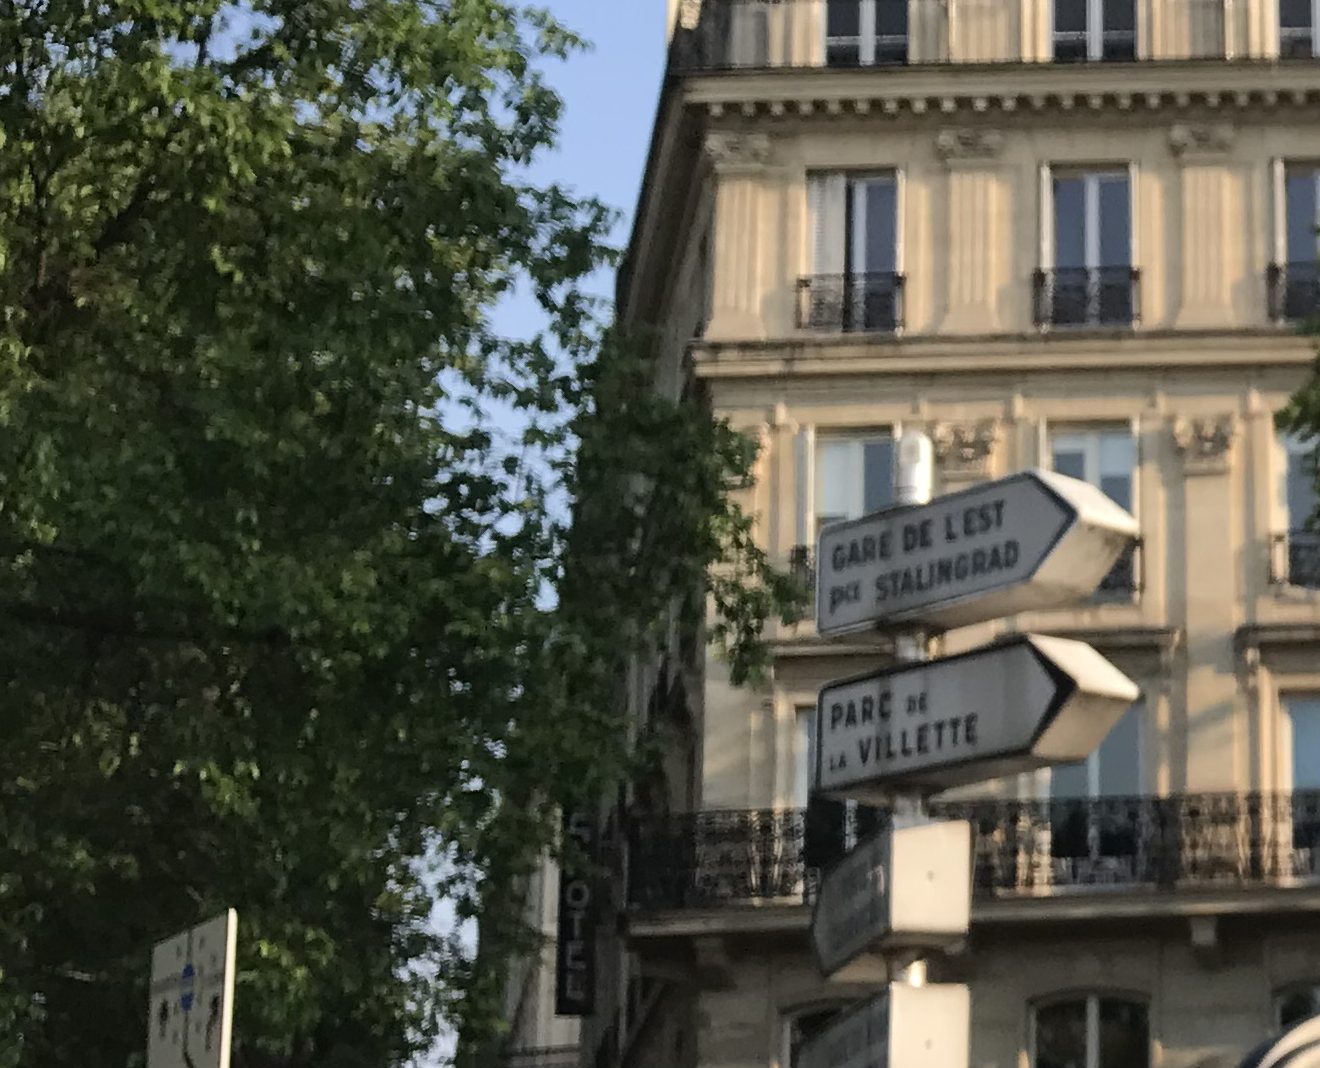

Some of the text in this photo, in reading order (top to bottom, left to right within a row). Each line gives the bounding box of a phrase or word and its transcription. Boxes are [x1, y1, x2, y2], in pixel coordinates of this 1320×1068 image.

[832, 529, 893, 572] GARE
[903, 518, 934, 553] DE
[875, 539, 1020, 602] STALINGRAD
[830, 690, 928, 730] PARC DE
[829, 711, 979, 772] LA VILLETTE
[562, 852, 592, 1000] OTEL
